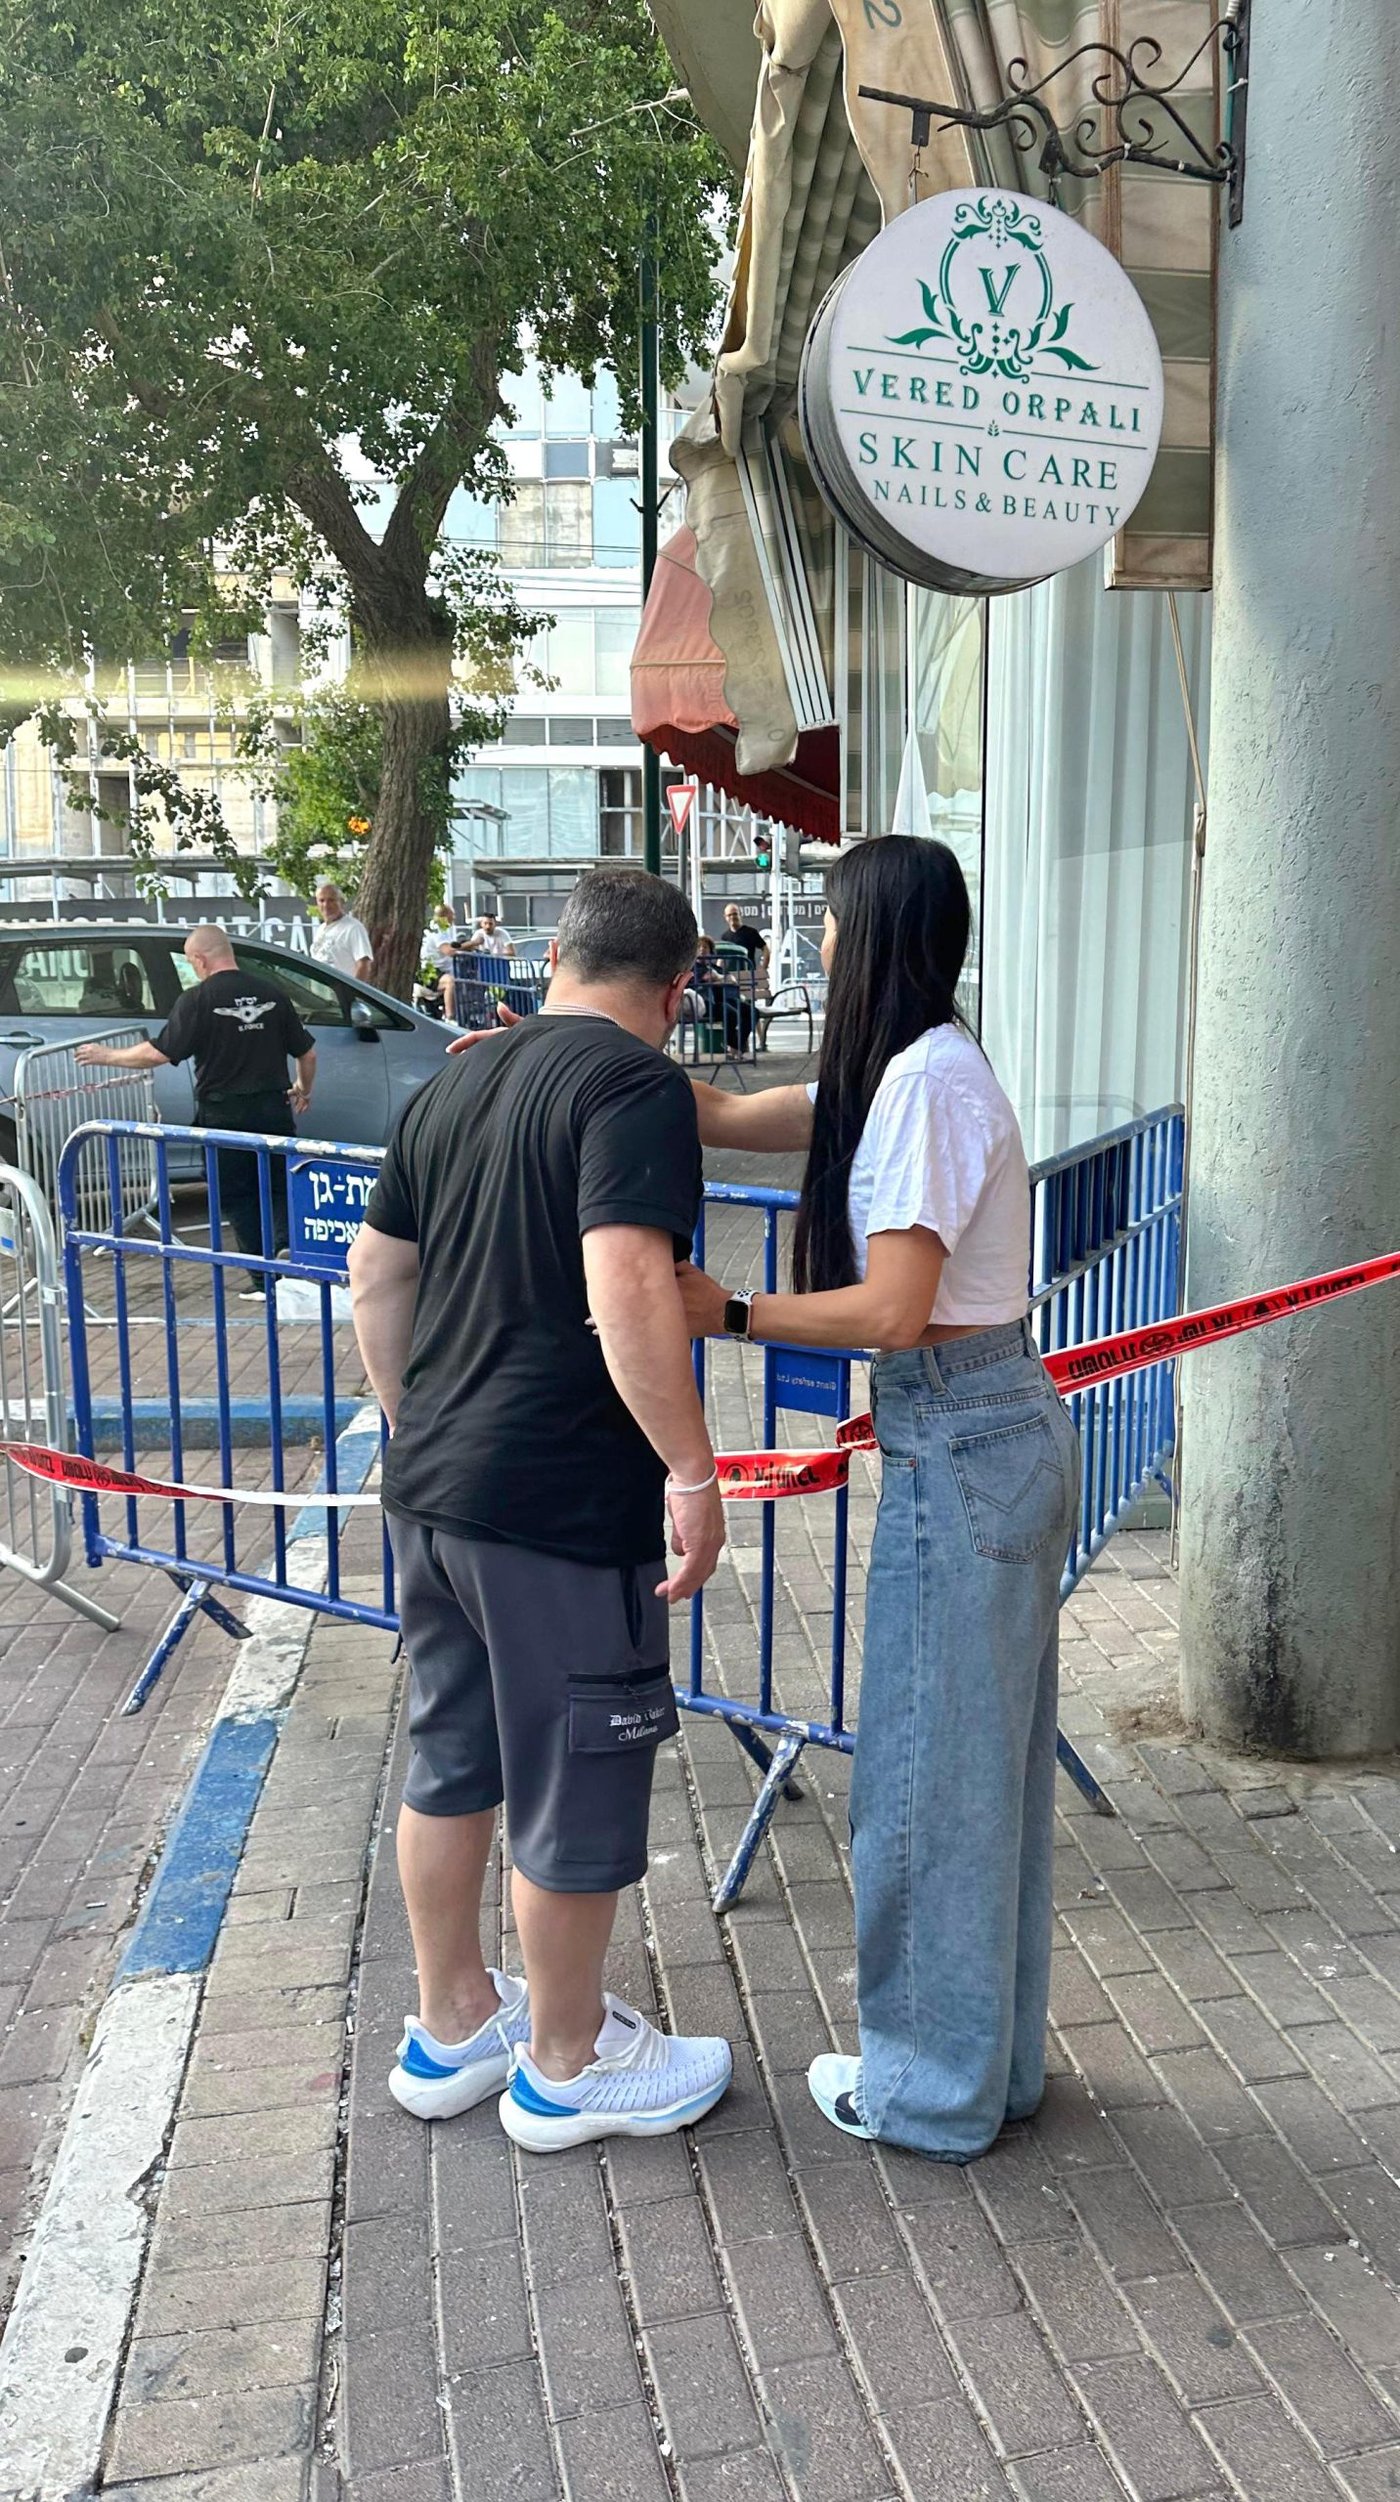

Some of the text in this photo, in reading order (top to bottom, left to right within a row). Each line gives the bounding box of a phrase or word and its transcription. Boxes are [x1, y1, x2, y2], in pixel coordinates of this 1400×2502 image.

[978, 263, 1021, 317] V
[852, 368, 1141, 432] VERED ORPALI
[859, 432, 1118, 490] SKIN CARE
